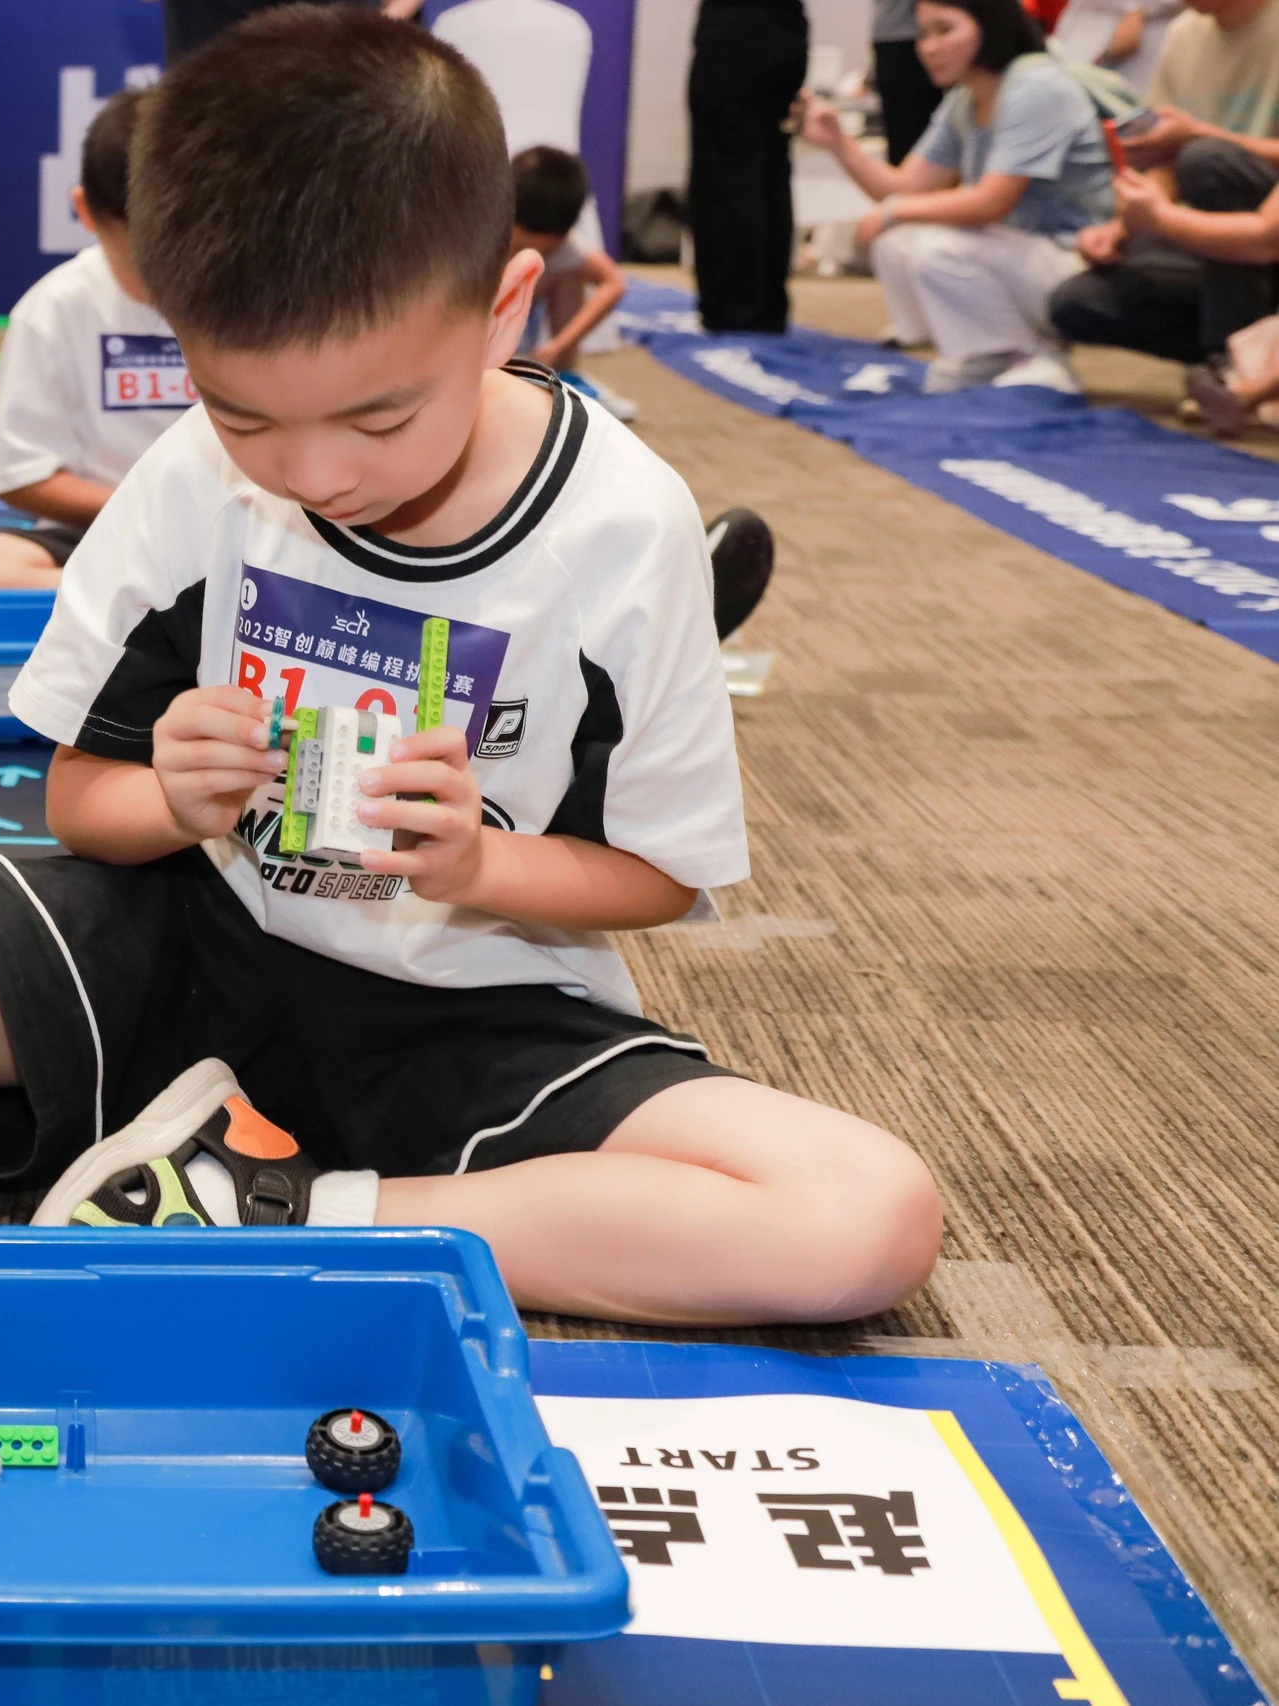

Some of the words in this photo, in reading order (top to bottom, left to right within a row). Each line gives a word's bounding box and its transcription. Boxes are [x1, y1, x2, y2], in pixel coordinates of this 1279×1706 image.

[238, 616, 475, 697] 2025智创巅峰编程挑赛
[313, 872, 404, 901] SPEED
[620, 1446, 821, 1472] START
[596, 1486, 932, 1577] 起点
